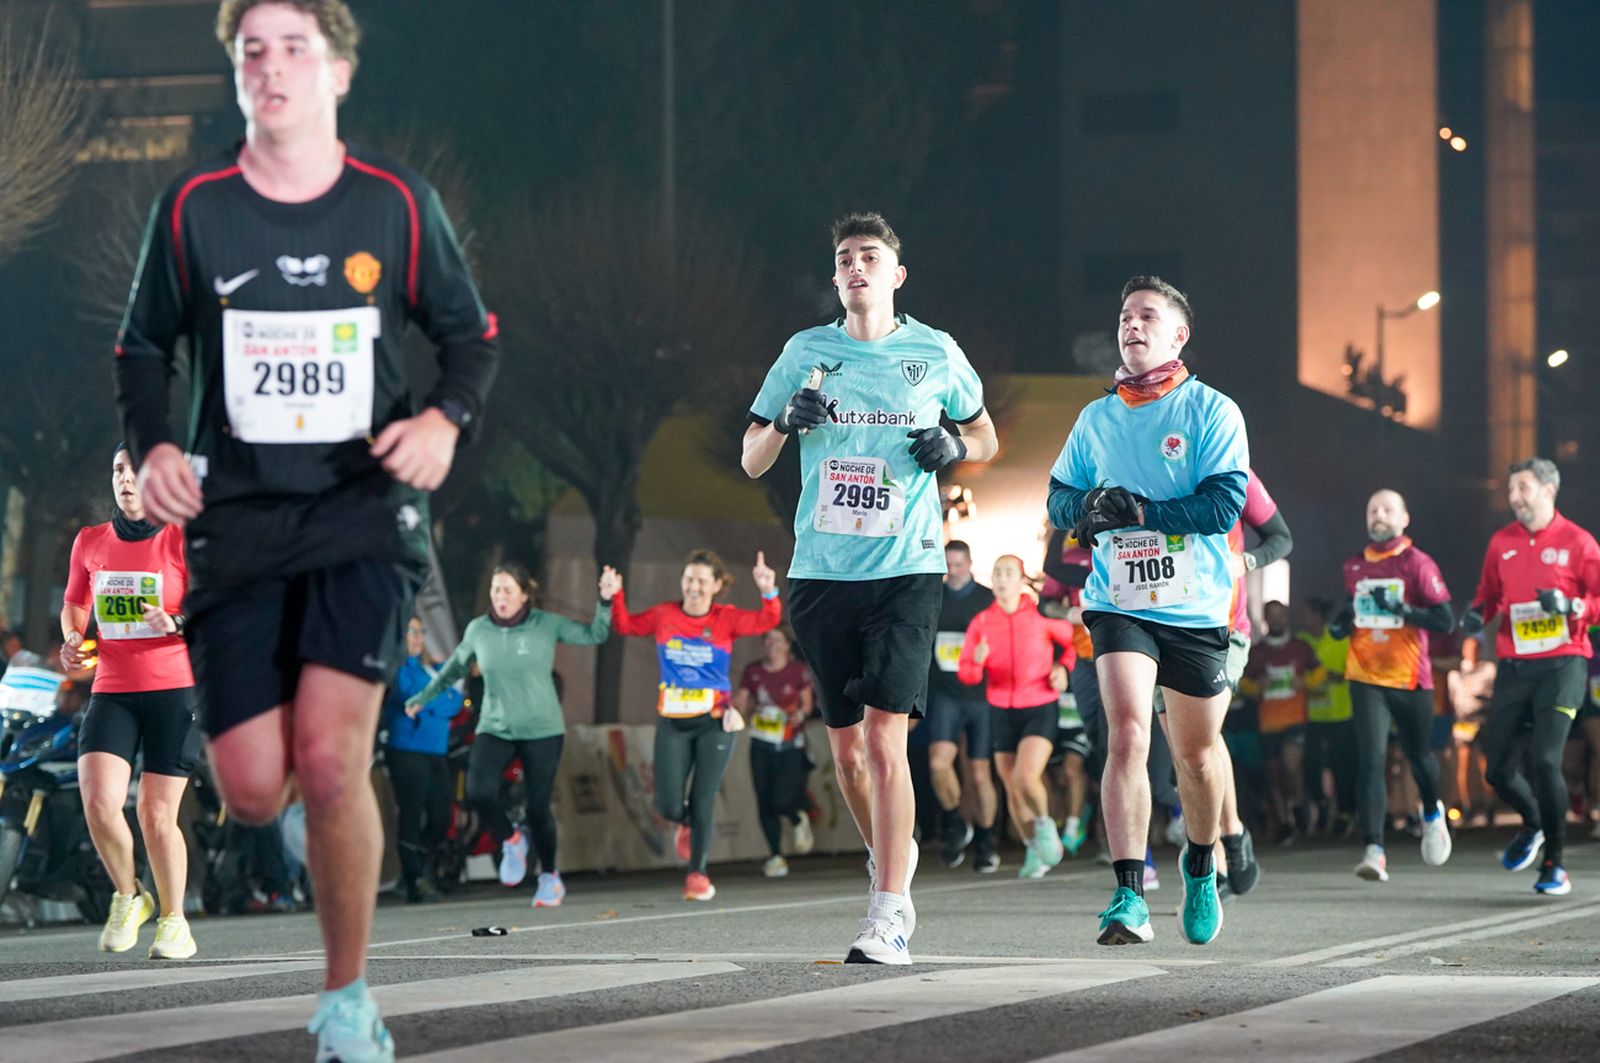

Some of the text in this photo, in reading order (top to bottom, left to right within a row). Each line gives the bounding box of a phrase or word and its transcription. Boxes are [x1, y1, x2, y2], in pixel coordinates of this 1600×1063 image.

[253, 361, 344, 396] 2989
[840, 464, 865, 473] NOCHE
[866, 465, 876, 474] DE
[829, 473, 845, 481] SAN
[832, 483, 891, 512] 2995
[1125, 539, 1147, 549] NOCHE
[1149, 538, 1159, 547] DE
[1118, 550, 1132, 560] SAN
[1125, 556, 1175, 583] 7108
